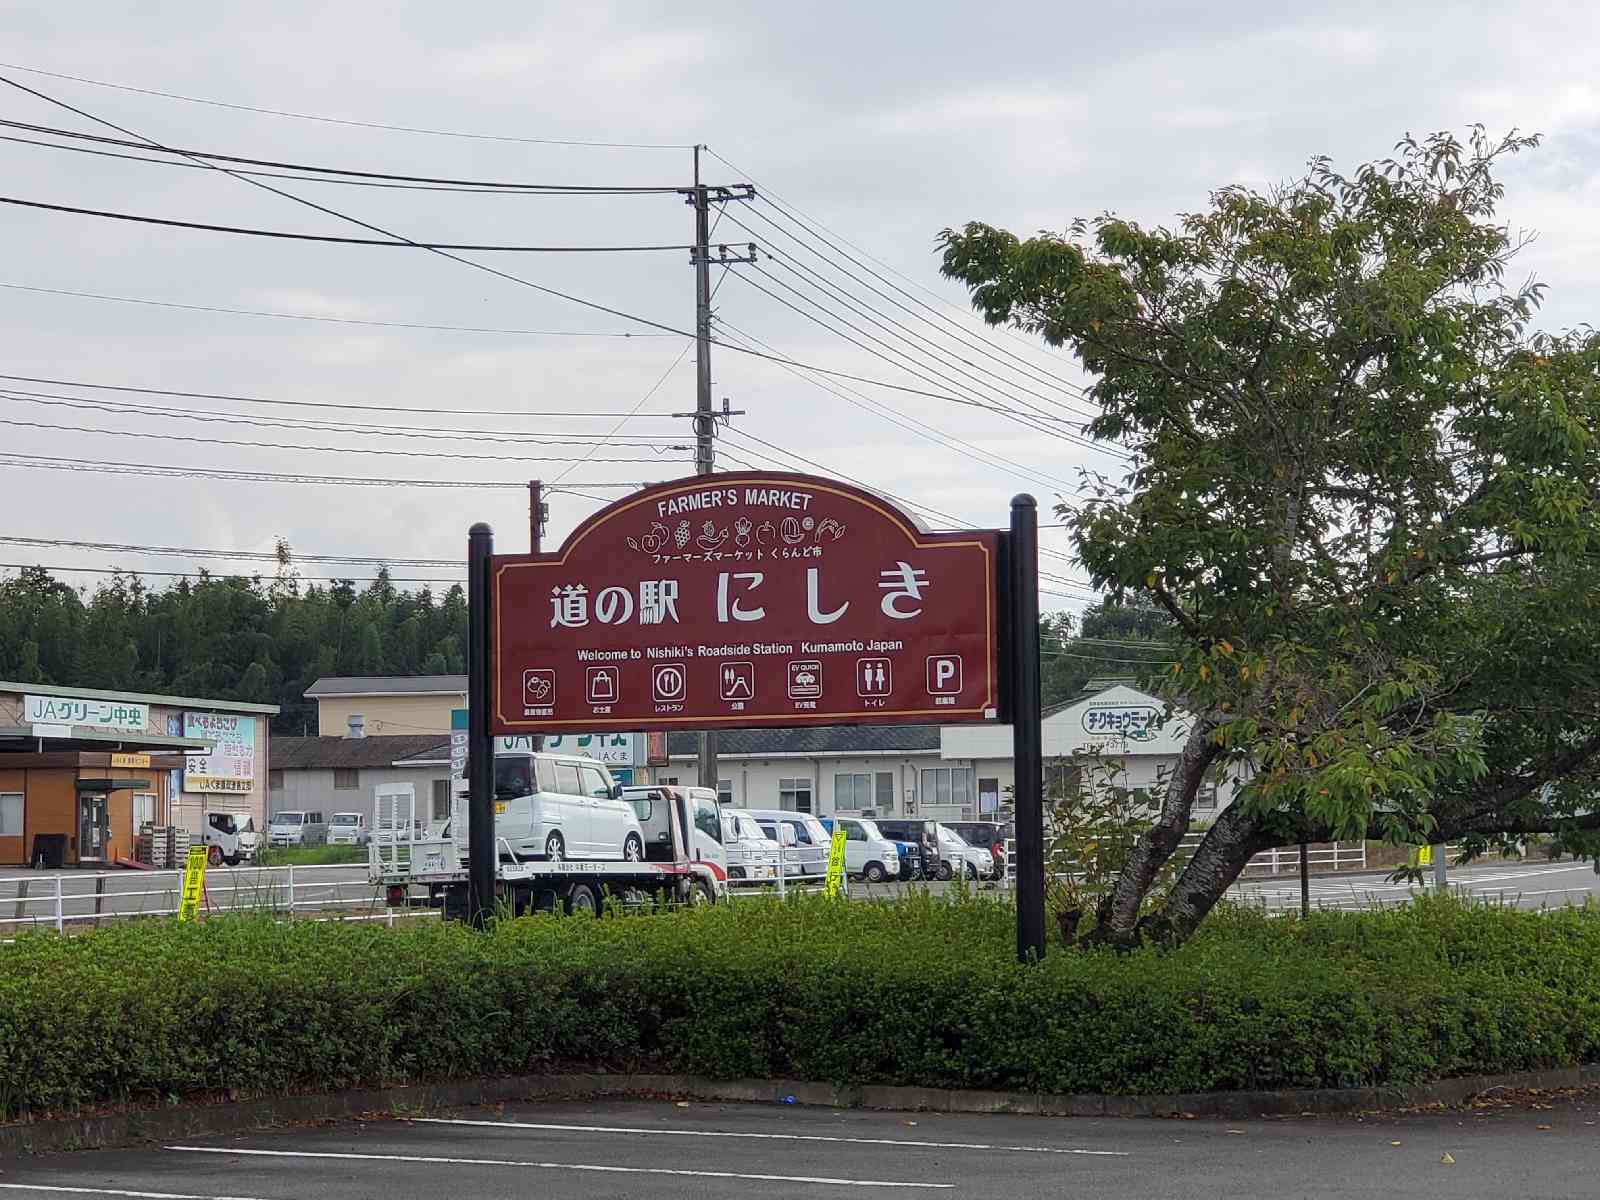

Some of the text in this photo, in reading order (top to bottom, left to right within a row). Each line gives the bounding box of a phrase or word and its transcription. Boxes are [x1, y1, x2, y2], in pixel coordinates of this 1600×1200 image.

[657, 489, 813, 518] FARMER'S MARKET
[652, 546, 823, 564] ファーマーズマーケット くらんど市
[550, 561, 930, 629] 道の駅 にしき
[577, 639, 903, 661] Welcome to Nishiki's Roadside Station Kumamoto Japan
[936, 659, 955, 689] P
[33, 699, 142, 726] JAグリーン中央
[655, 704, 684, 713] レストラン
[864, 699, 886, 707] トイレ
